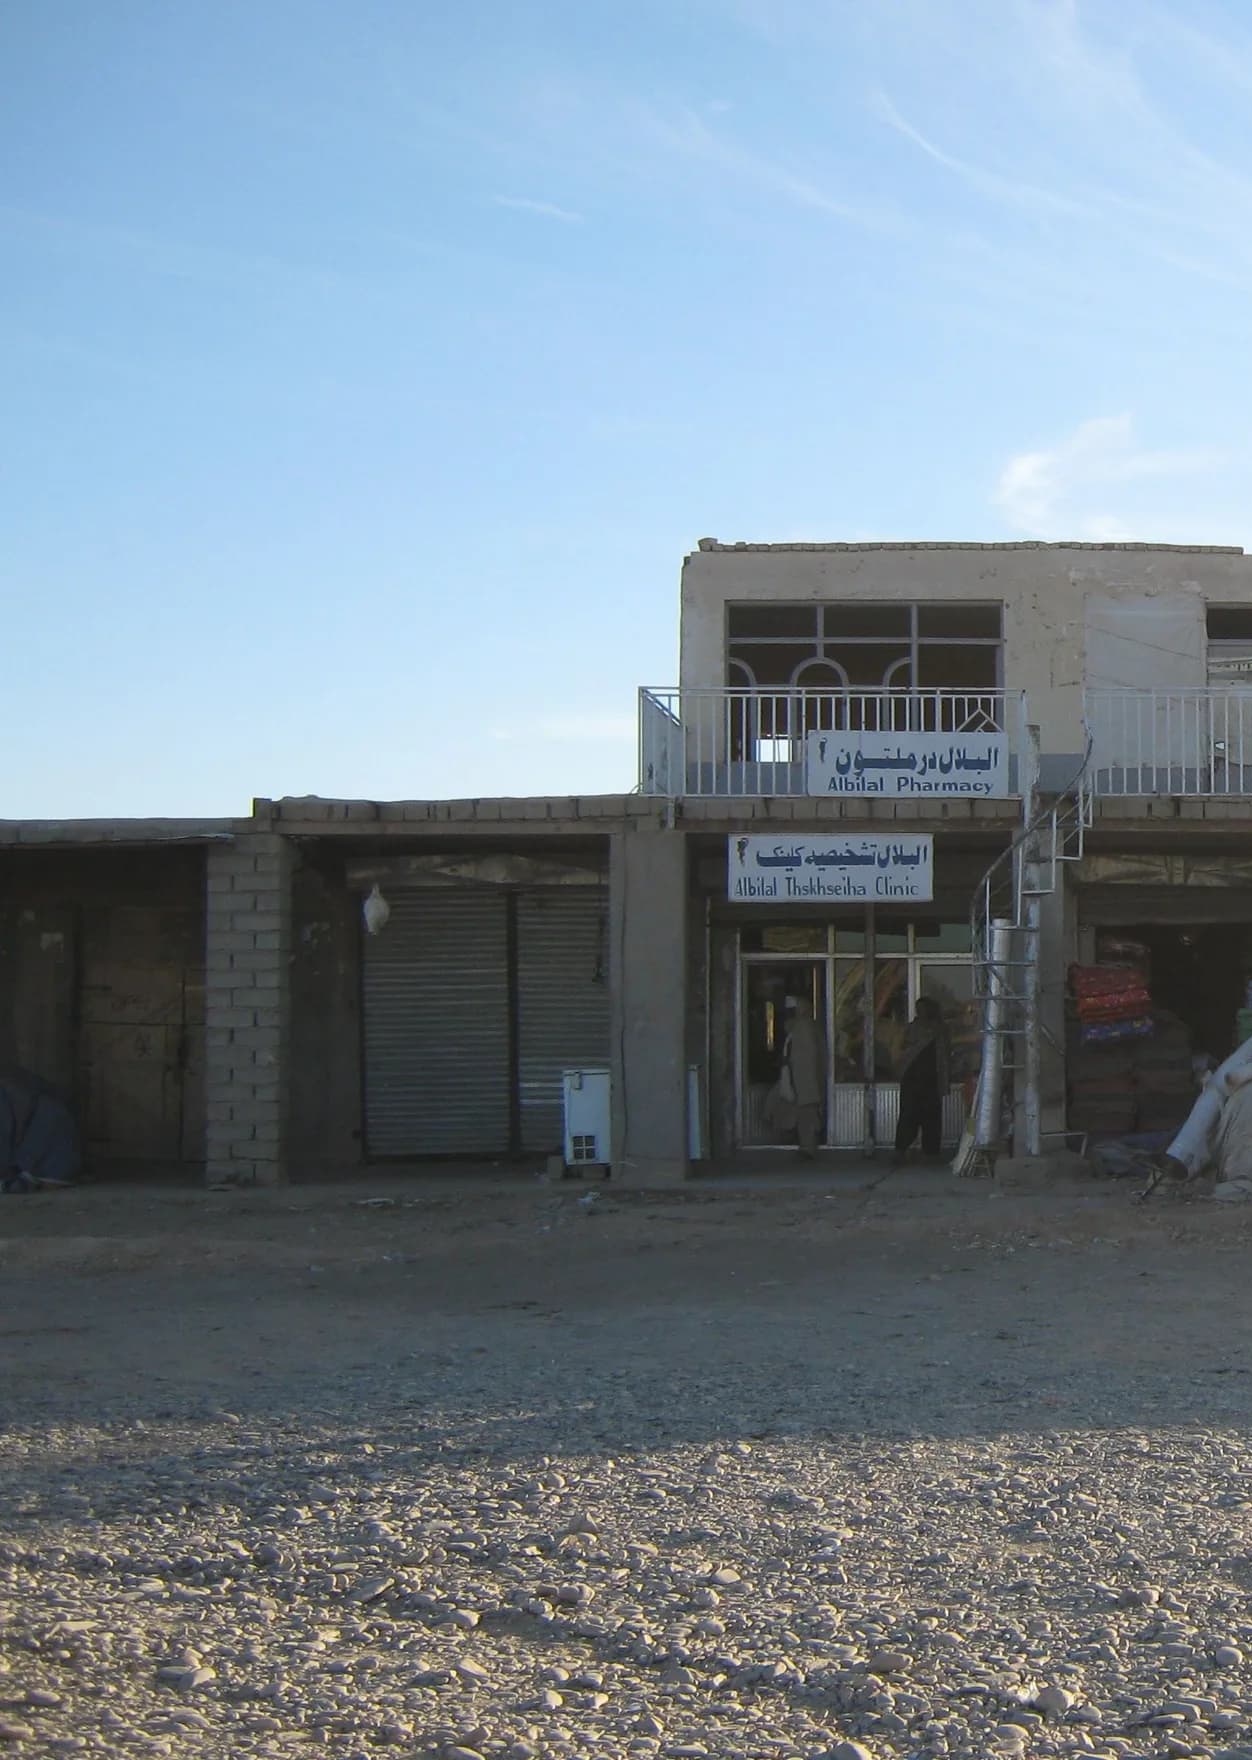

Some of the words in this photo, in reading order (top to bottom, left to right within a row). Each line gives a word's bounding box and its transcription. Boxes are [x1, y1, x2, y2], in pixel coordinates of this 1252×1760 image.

[835, 746, 937, 777] درملتون
[939, 746, 999, 775] البلال
[828, 776, 884, 792] Albilal
[897, 776, 995, 795] Pharmacy
[877, 844, 928, 871] البلال
[735, 876, 776, 897] Albilal
[784, 875, 866, 897] Thskhseiha
[875, 875, 919, 897] Clinic
